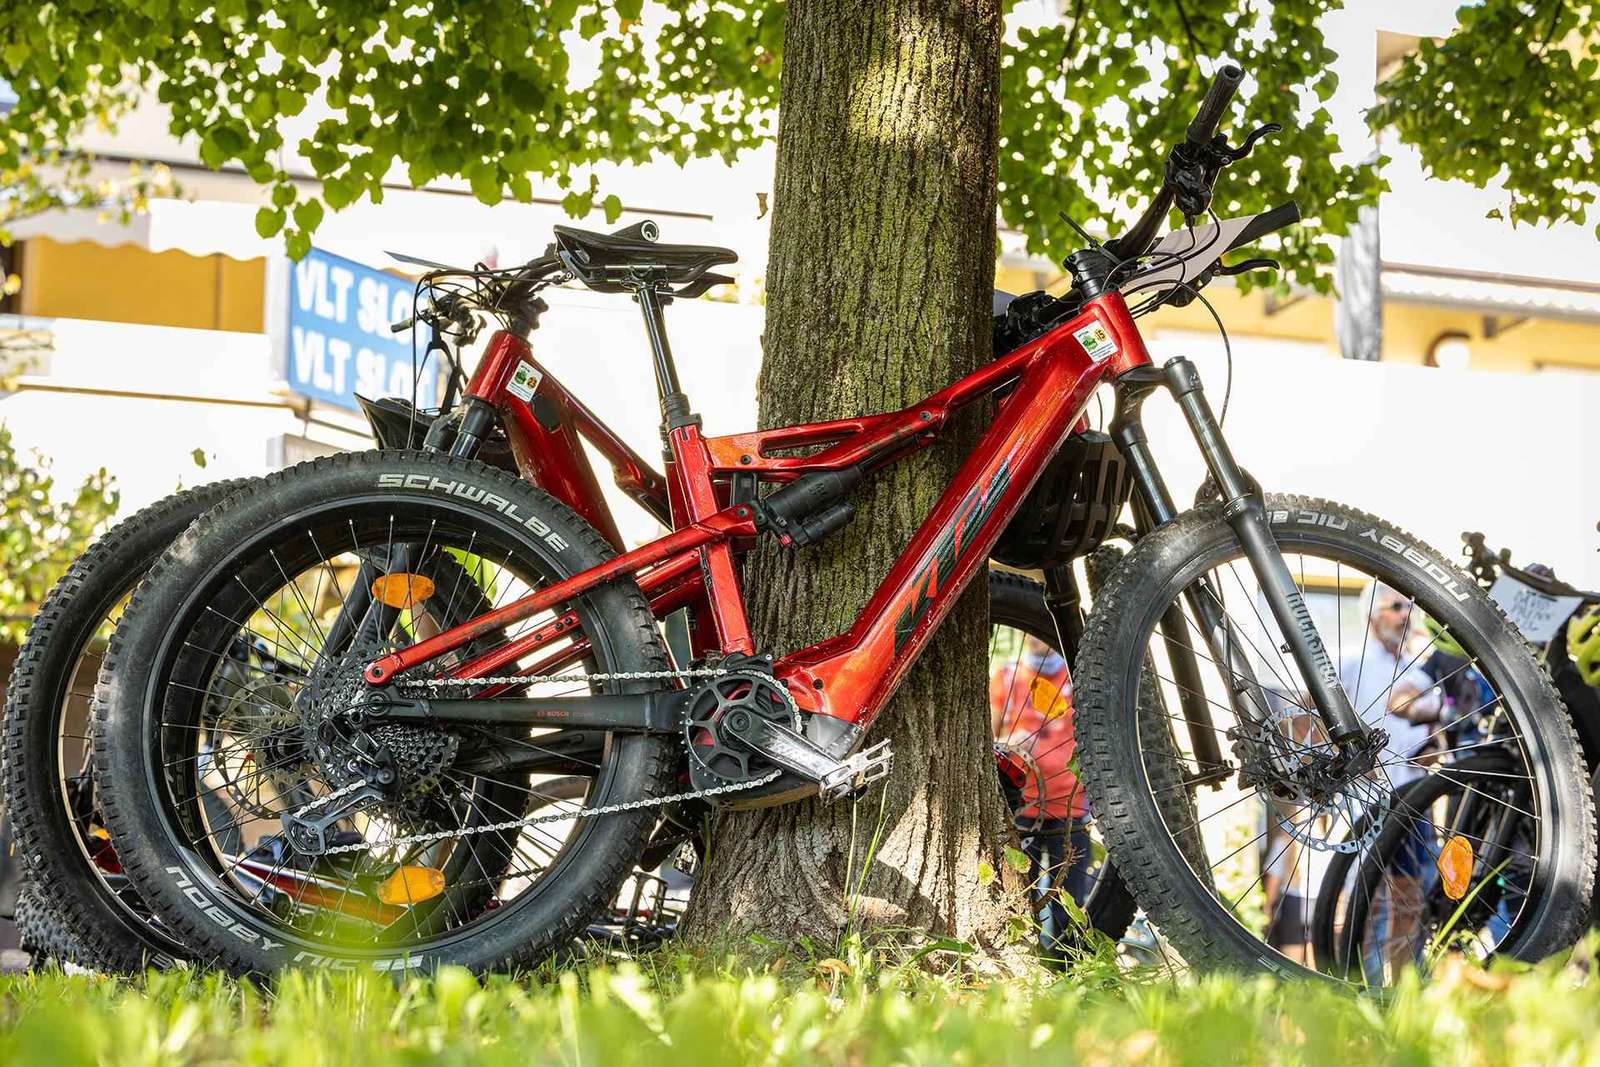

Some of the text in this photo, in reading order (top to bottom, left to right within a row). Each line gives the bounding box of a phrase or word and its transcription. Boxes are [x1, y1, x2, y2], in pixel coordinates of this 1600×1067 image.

[296, 257, 354, 323] VLT
[292, 325, 352, 396] VLT
[377, 473, 570, 552] SCHWALBE
